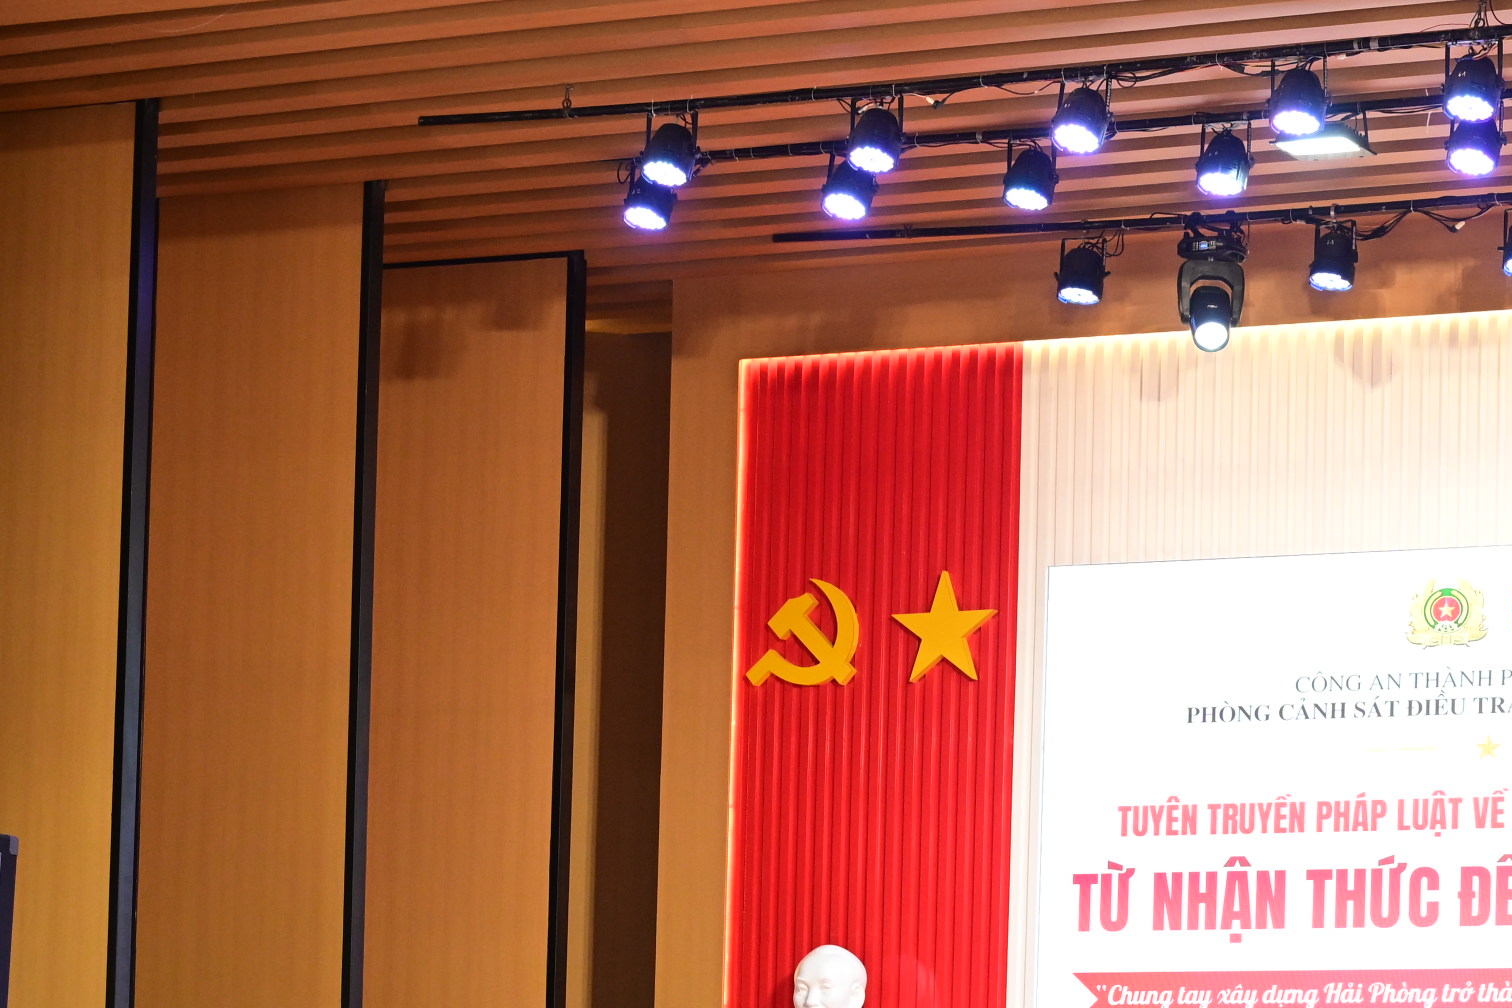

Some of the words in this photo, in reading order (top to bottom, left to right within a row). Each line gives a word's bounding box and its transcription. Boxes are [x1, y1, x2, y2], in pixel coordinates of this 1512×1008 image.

[1295, 671, 1362, 694] CÔNG
[1369, 672, 1402, 692] AN
[1409, 665, 1494, 689] THÀNH
[1186, 700, 1271, 724] PHÒNG
[1278, 697, 1347, 721] CẢNH
[1353, 695, 1400, 719] SÁT
[1406, 689, 1467, 717] ĐIỀU
[1118, 795, 1198, 837] TUYÊN
[1207, 794, 1306, 835] TRUYỀN
[1316, 791, 1388, 833] PHÁP
[1397, 790, 1463, 838] LUẬT
[1473, 788, 1509, 829] VỀ
[1072, 860, 1144, 932] TỪ
[1153, 855, 1287, 944] NHẬN
[1306, 854, 1440, 929] THỨC
[1322, 981, 1365, 1005] Hải
[1440, 980, 1475, 1003] trở
